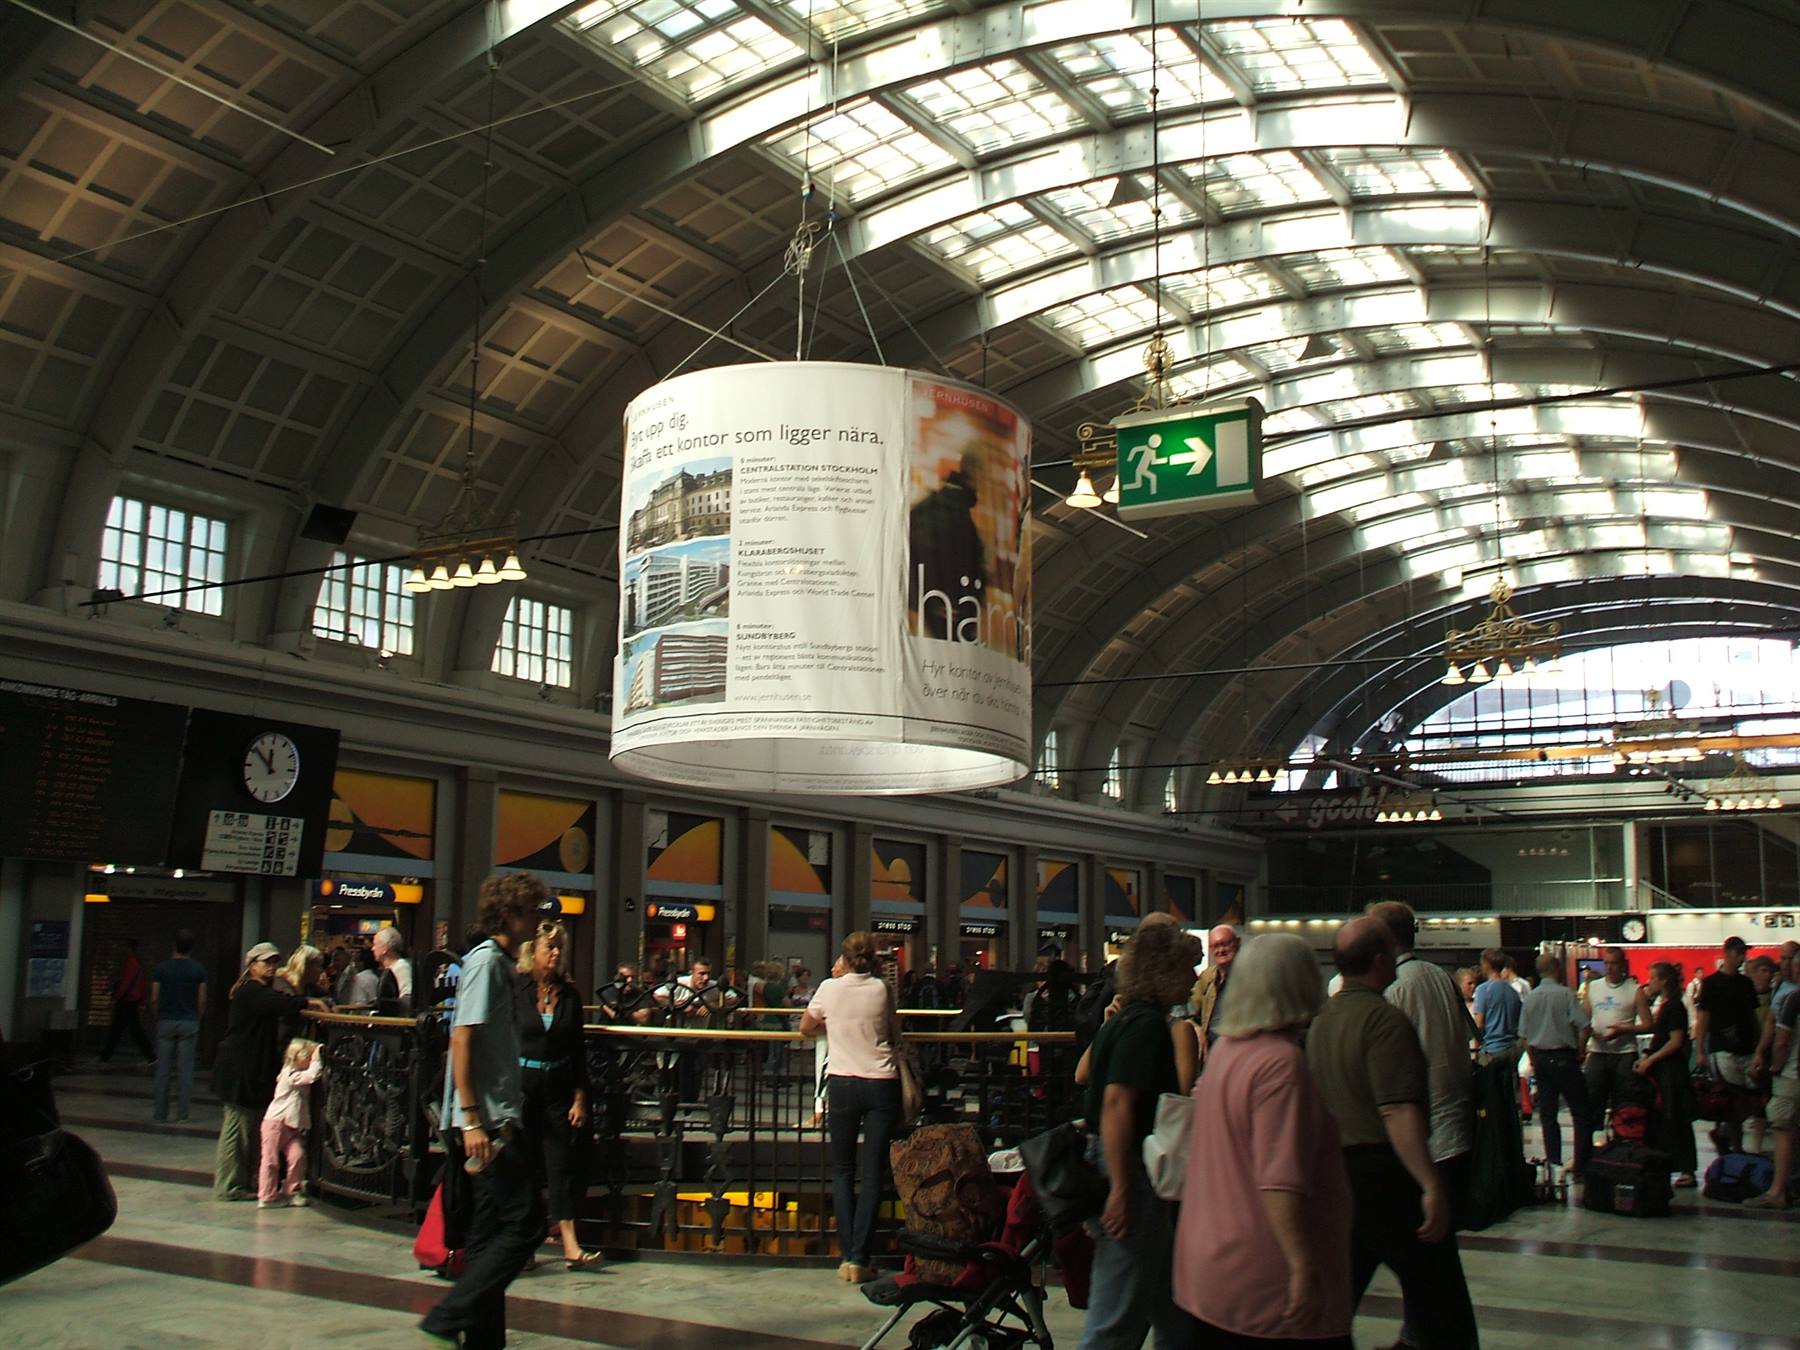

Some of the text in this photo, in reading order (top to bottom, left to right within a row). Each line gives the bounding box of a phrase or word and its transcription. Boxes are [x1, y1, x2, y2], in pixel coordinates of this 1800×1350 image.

[668, 412, 690, 431] dig.
[655, 444, 675, 459] ett
[677, 432, 729, 452] kontor
[735, 427, 772, 444] som
[779, 423, 832, 445] ligger
[838, 426, 884, 445] nära.
[740, 465, 879, 475] CENTRALSTATION STOCKHOLM
[738, 547, 825, 557] KLARABERGSHUSET
[736, 632, 796, 641] SUNDBYBERG
[922, 659, 945, 678] Hyr
[949, 662, 982, 681] kontor
[922, 682, 948, 698] över
